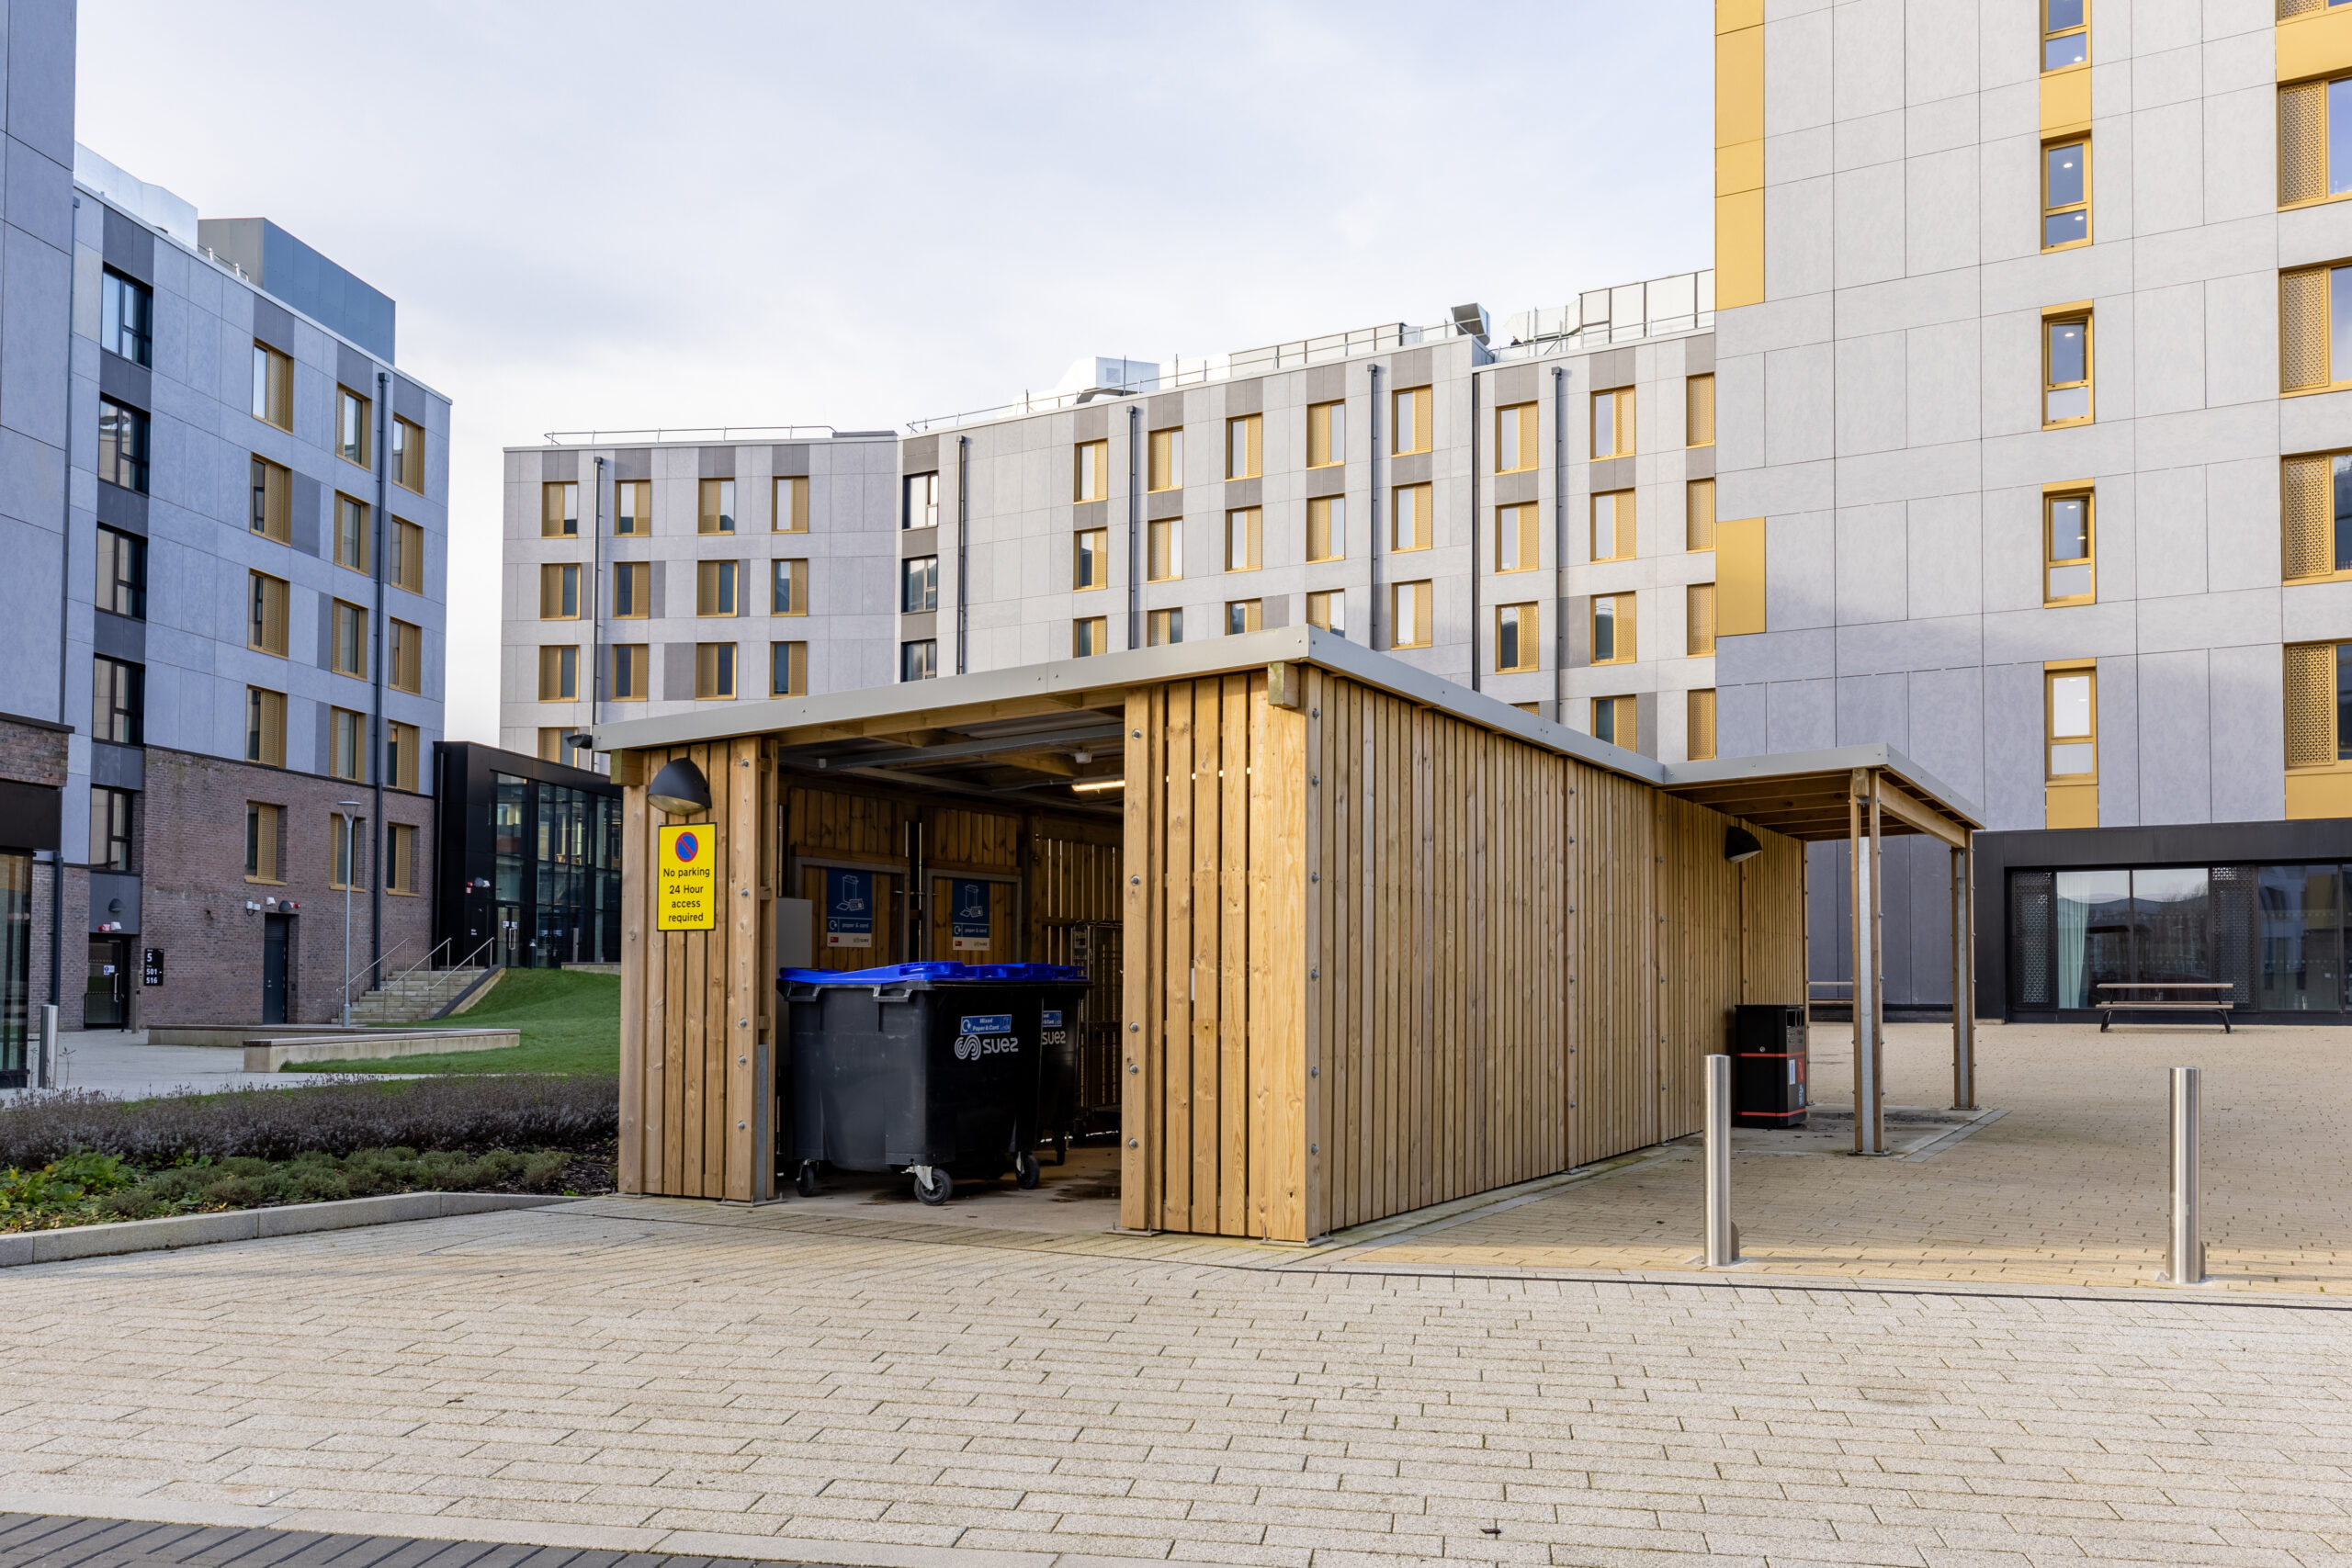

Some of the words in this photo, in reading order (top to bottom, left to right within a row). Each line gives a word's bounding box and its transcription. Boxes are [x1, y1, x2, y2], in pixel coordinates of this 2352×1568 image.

[663, 868, 675, 877] No
[678, 867, 710, 878] parking
[669, 886, 681, 894] 24
[684, 885, 704, 894] Hour
[672, 900, 701, 908] access
[668, 912, 704, 923] required
[147, 953, 153, 962] 5
[982, 1037, 1019, 1054] suez
